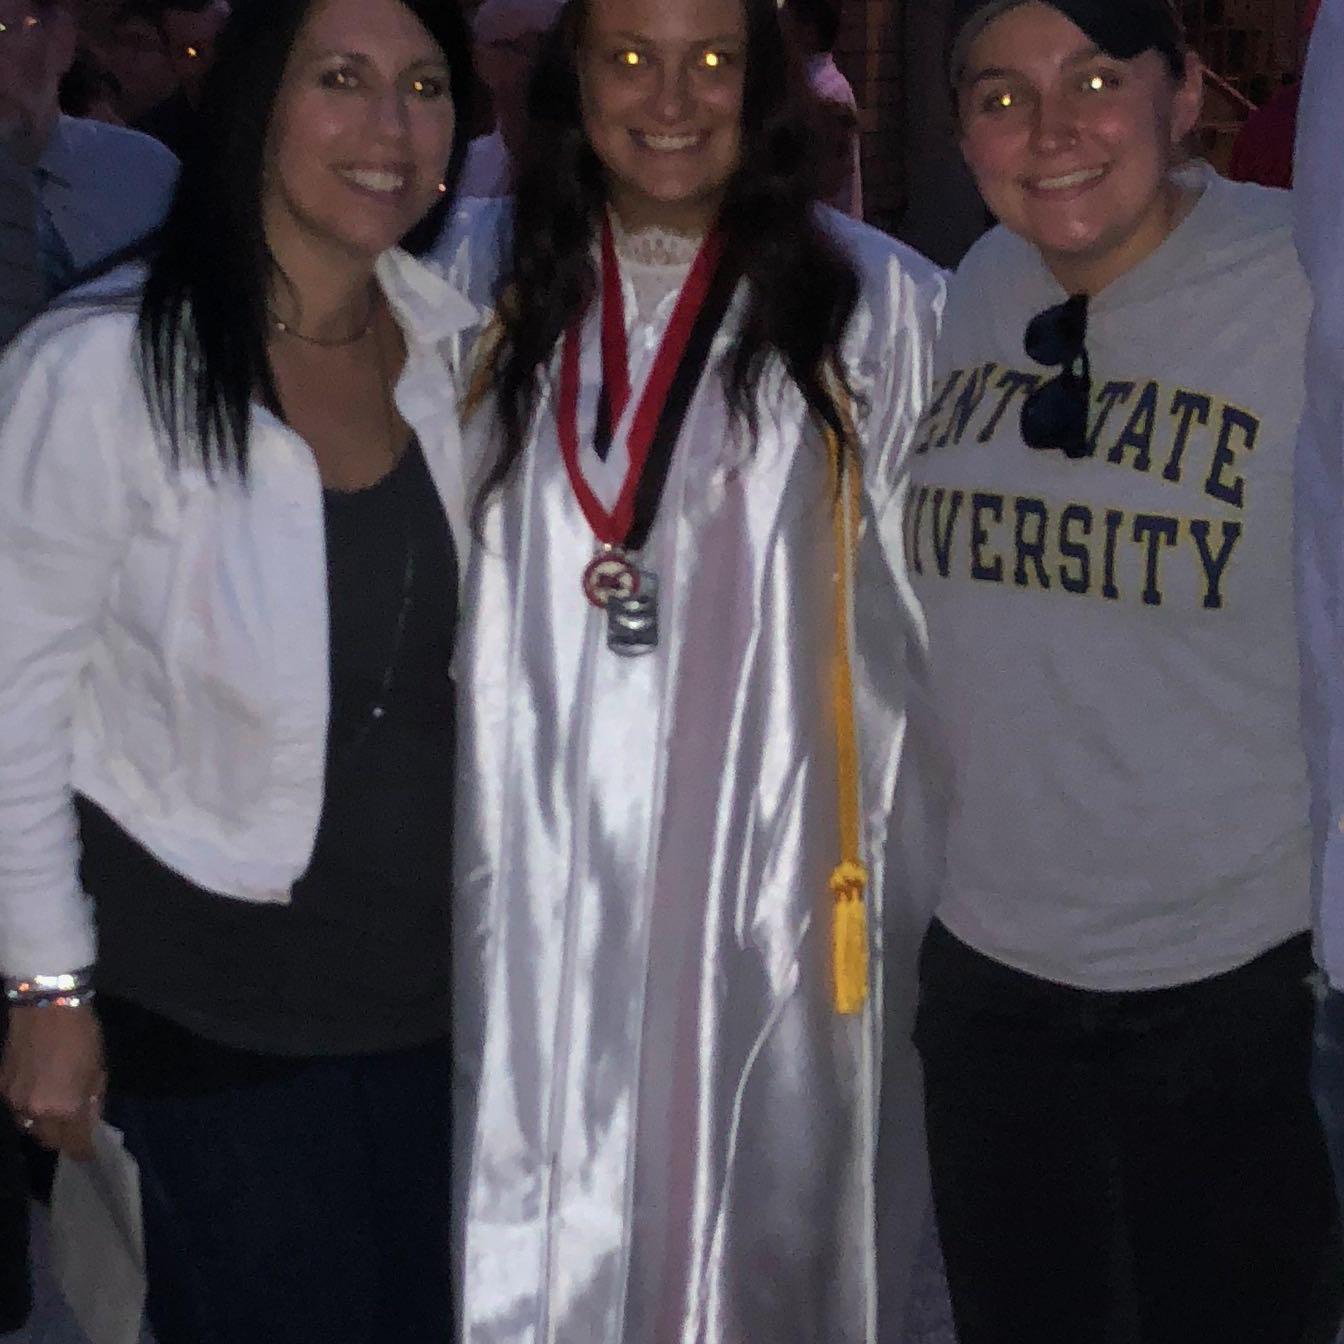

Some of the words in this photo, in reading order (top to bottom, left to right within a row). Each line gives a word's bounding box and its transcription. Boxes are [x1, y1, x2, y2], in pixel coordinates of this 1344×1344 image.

[914, 362, 1043, 454] ENT
[1084, 380, 1261, 509] TATE
[902, 486, 1242, 609] IVERSITY
